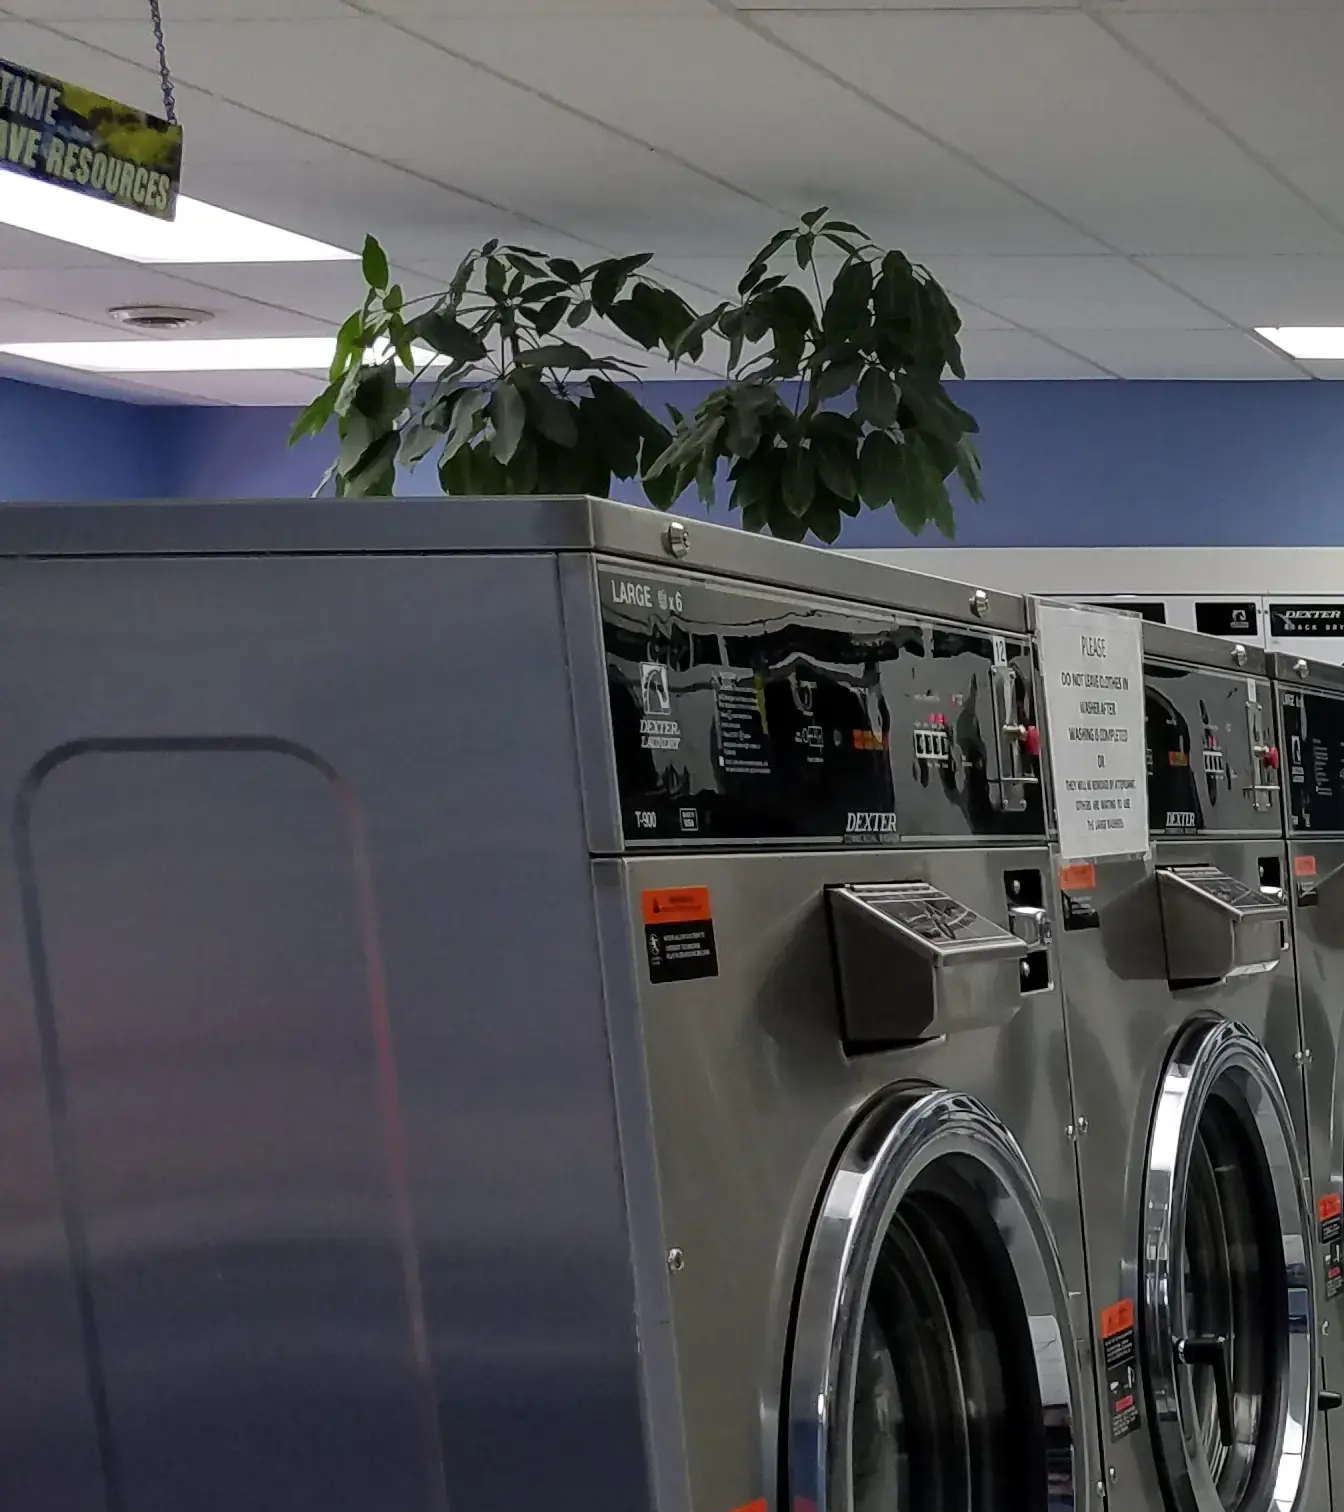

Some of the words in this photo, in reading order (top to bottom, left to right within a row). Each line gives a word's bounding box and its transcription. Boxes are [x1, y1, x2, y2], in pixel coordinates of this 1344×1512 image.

[45, 135, 171, 211] RESOURCES
[611, 579, 652, 608] LARGE
[1285, 610, 1342, 619] DEXTER
[994, 640, 1006, 663] 12
[1081, 635, 1107, 659] PLEASE
[1061, 671, 1071, 687] DO
[1072, 673, 1084, 687] NOT
[1085, 673, 1099, 689] LEAVE
[1100, 675, 1121, 690] CLOTHES
[1122, 676, 1129, 691] IN
[1080, 701, 1100, 714] WASHER
[1101, 702, 1117, 716] AFTER
[639, 719, 681, 735] DEXTER
[846, 812, 897, 832] DEXTER
